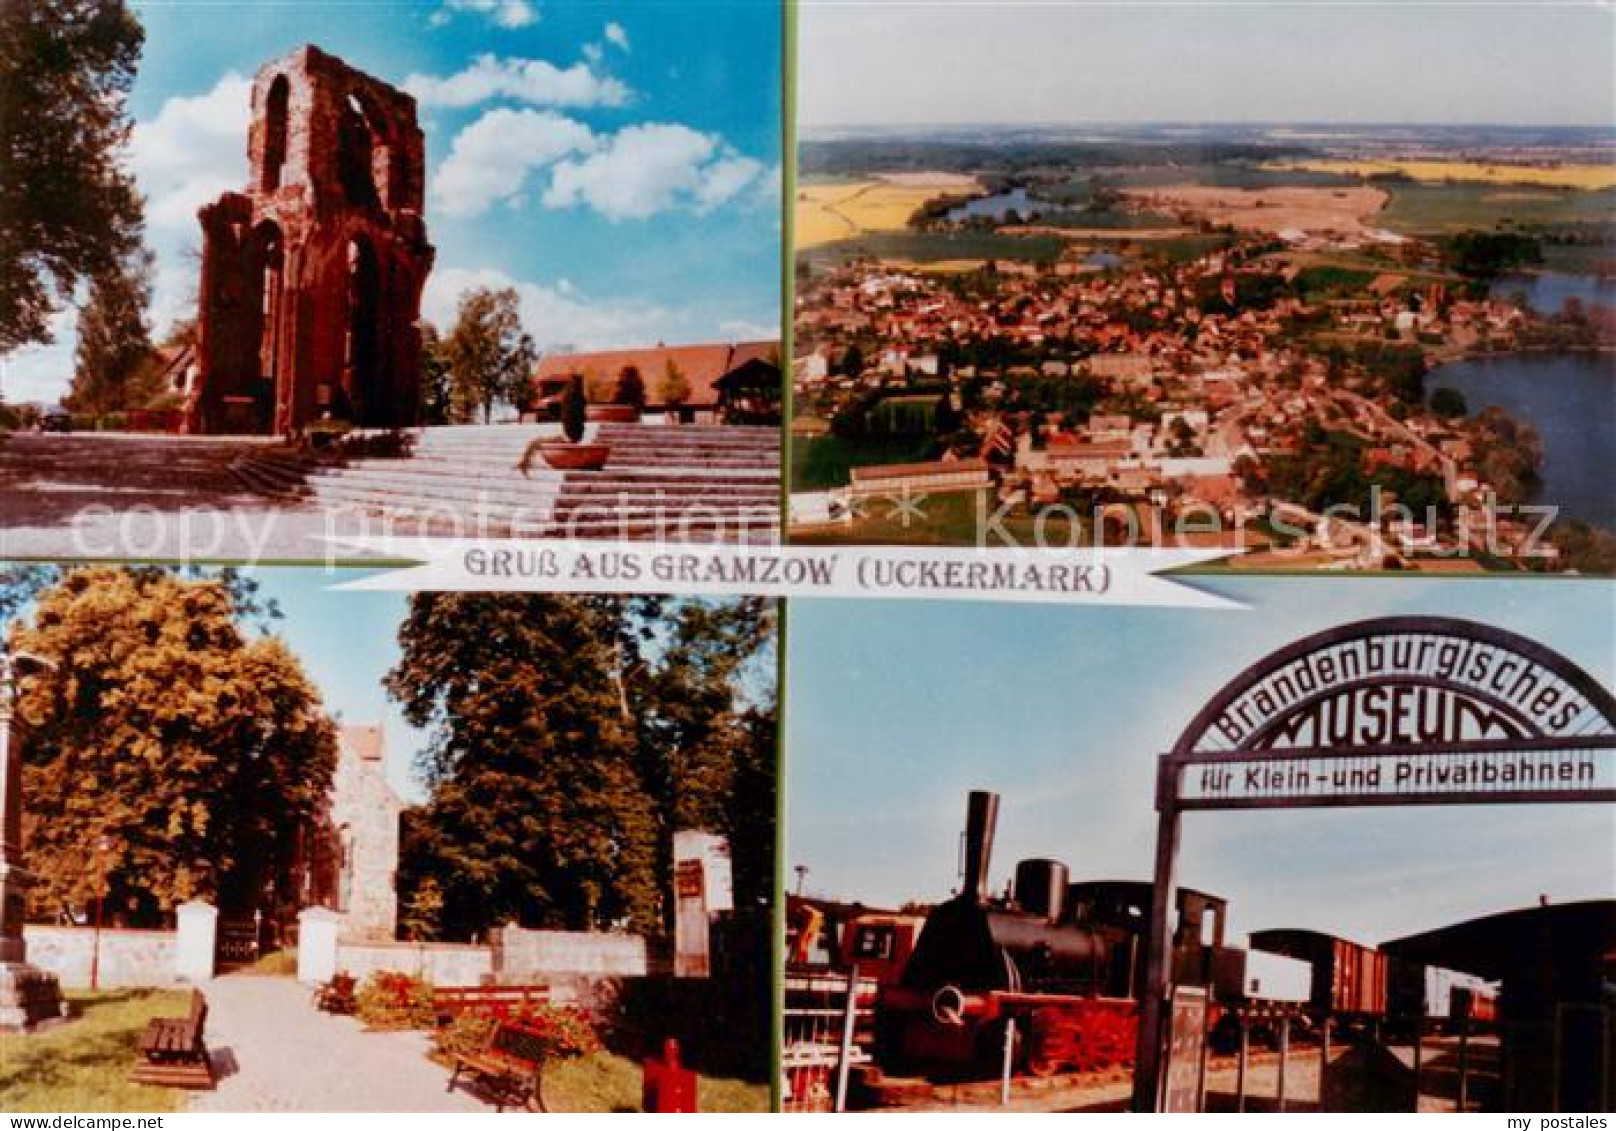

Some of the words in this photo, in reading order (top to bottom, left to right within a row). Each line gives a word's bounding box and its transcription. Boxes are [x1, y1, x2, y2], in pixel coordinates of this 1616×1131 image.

[1216, 634, 1580, 746] Brandenburgisches
[1248, 684, 1525, 750] MUSEUM
[1201, 767, 1233, 792] für
[1396, 756, 1594, 785] Privatbahnen
